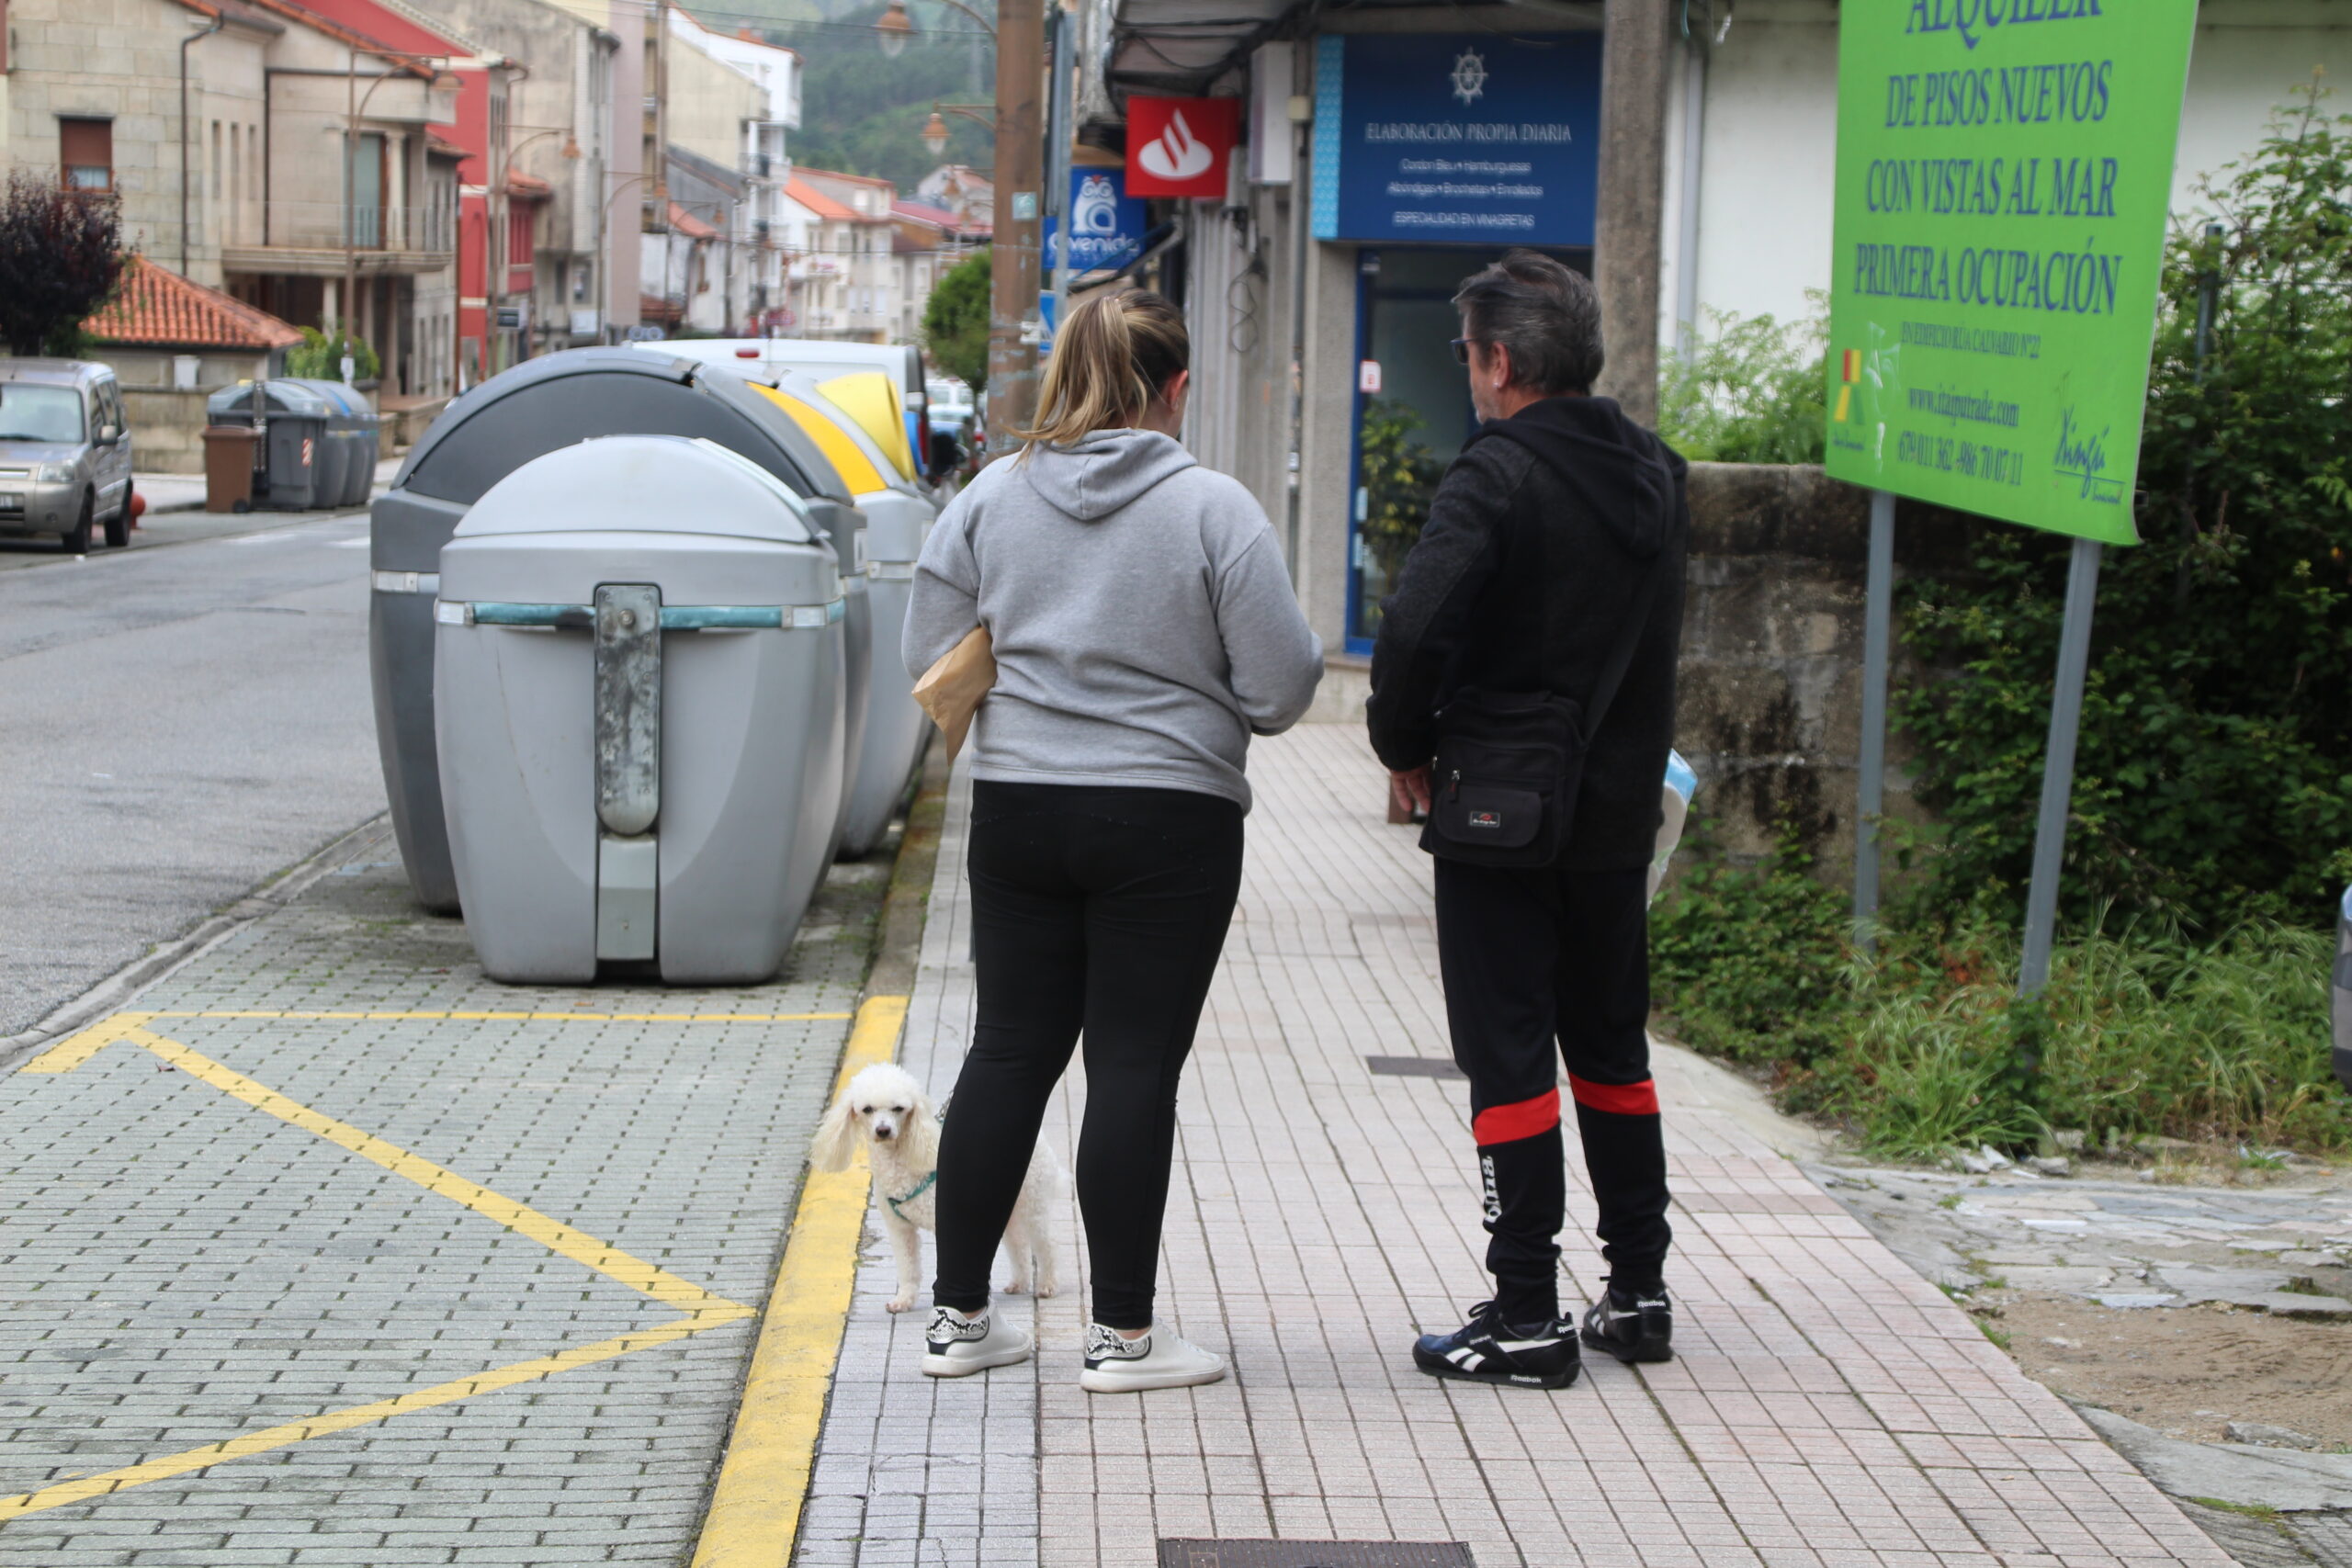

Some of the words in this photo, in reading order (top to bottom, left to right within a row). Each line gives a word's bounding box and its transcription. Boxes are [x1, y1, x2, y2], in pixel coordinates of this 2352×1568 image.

[1905, 0, 2103, 50] ALQU
[1885, 73, 1919, 128] DE
[1921, 67, 1992, 127] PISOS
[1994, 60, 2112, 124] NUEVOS
[1365, 120, 1464, 141] ELABORACIÓN
[1466, 123, 1518, 141] PROPIA
[1521, 123, 1572, 142] DIARIA
[1866, 158, 1917, 213] CON
[1919, 157, 2004, 215] VISTAS
[2005, 157, 2041, 215] AL
[2048, 157, 2119, 217] MAR
[1393, 211, 1461, 226] ESPECIALIDAD
[1461, 212, 1476, 227] EN
[1854, 243, 1951, 300] PRIMERA
[1956, 236, 2123, 316] OCUPACIÓN
[1637, 1300, 1667, 1308] Reebok
[1510, 1373, 1543, 1384] Reebok
